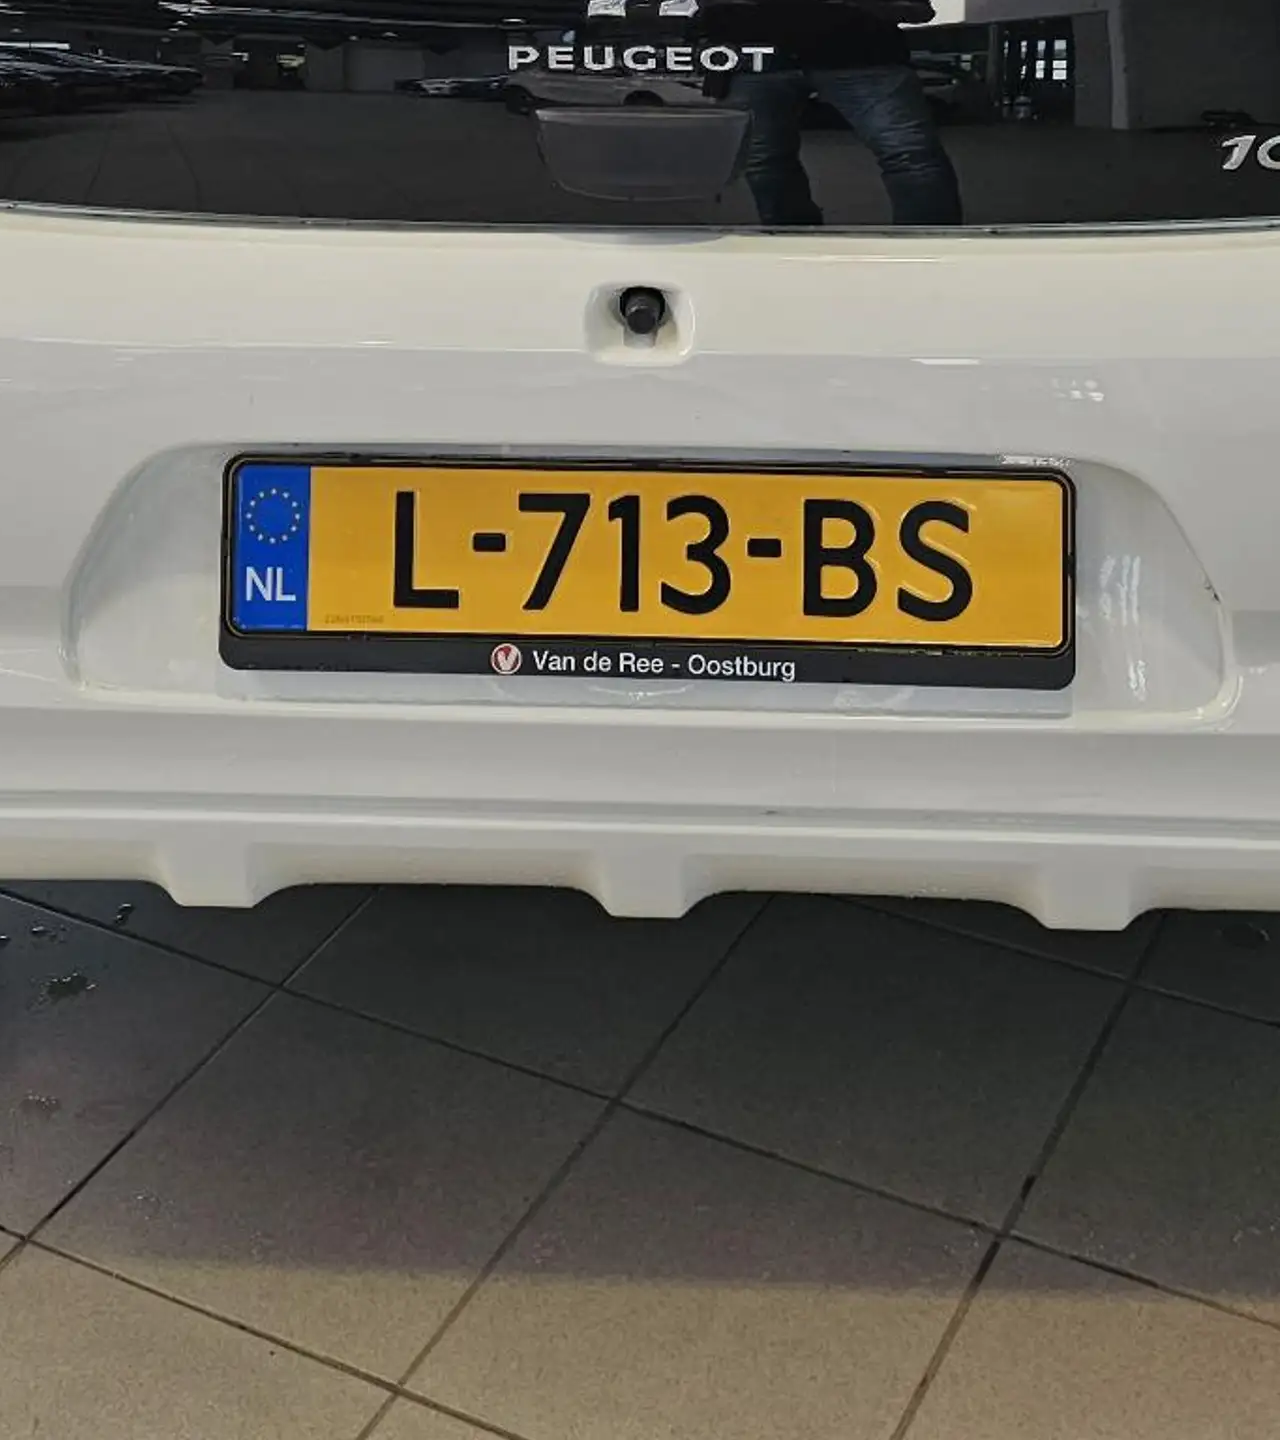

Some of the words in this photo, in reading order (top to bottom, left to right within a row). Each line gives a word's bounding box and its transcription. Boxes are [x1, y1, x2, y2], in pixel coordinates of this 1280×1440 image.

[508, 45, 774, 72] PEUGEOT
[393, 490, 973, 622] L-713-BS
[246, 566, 296, 601] NL
[533, 650, 576, 672] Van
[583, 651, 612, 673] de
[620, 652, 664, 674] Ree
[688, 653, 796, 683] Oostburg
